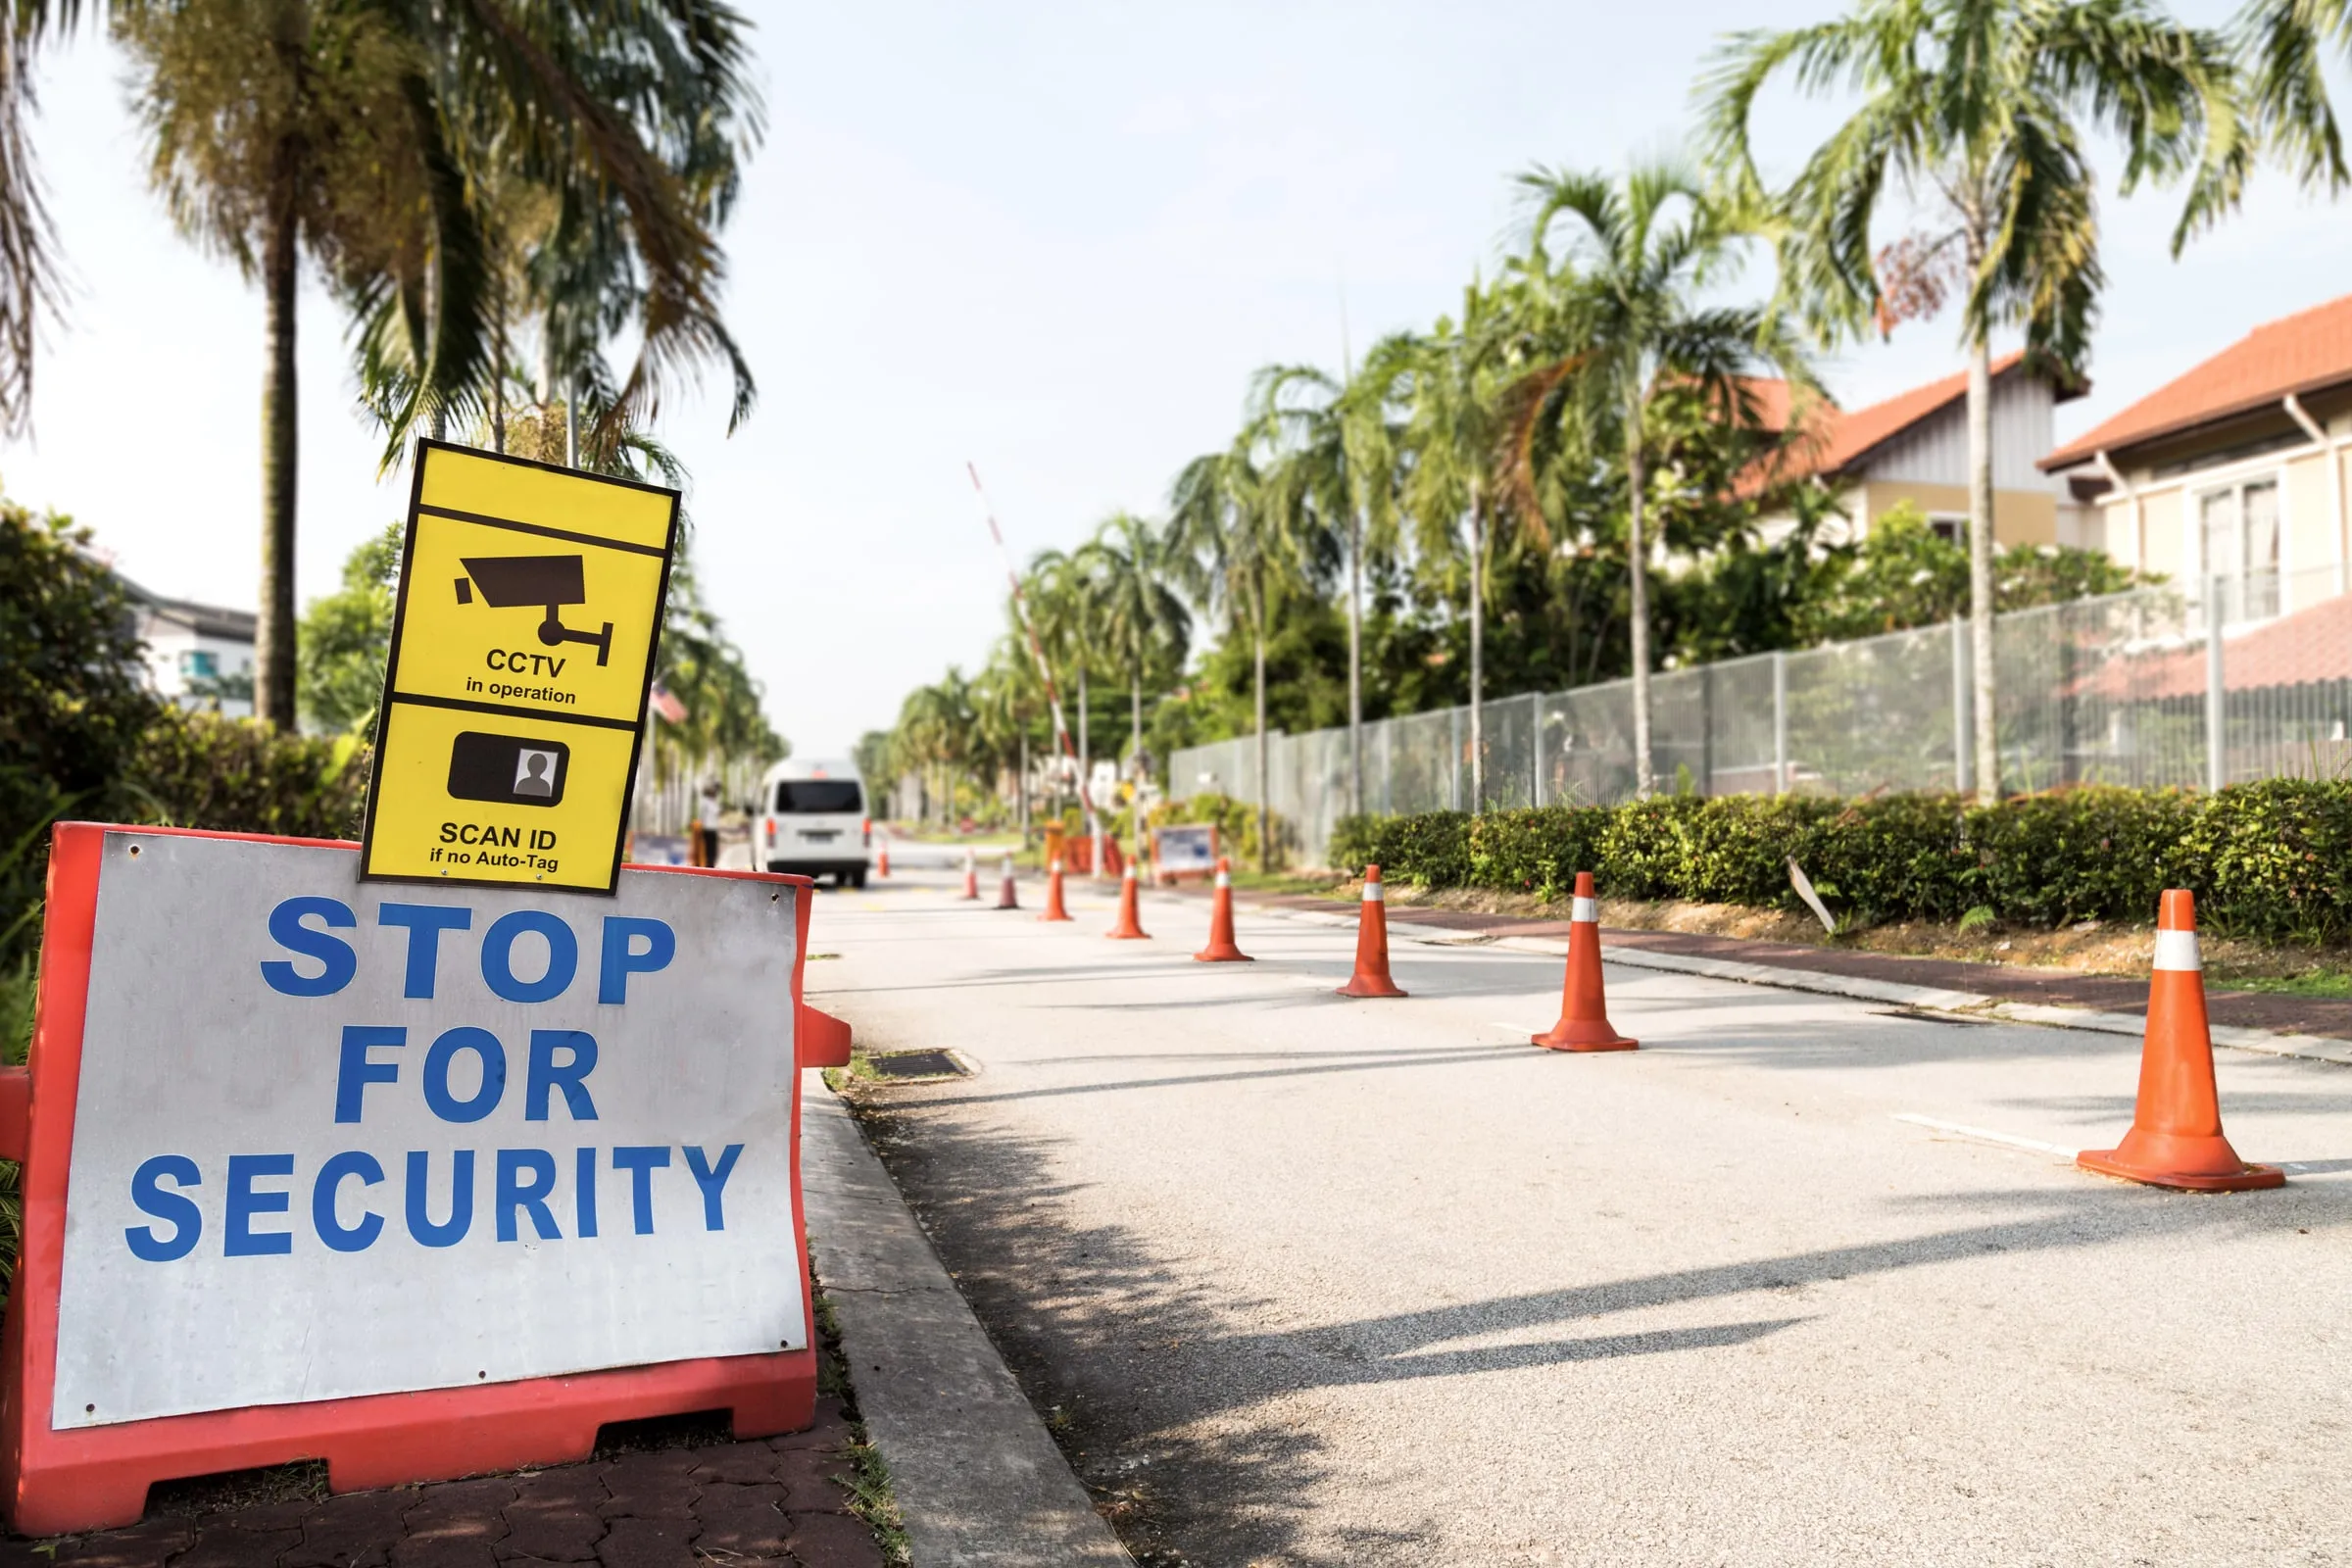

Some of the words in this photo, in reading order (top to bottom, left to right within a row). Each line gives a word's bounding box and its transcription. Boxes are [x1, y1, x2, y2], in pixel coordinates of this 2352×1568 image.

[486, 649, 566, 678] CCTV
[466, 676, 483, 692] in
[489, 683, 576, 705] operation
[439, 822, 521, 849] SCAN
[529, 829, 557, 851] ID
[429, 847, 444, 862] if
[447, 852, 471, 864] no
[475, 851, 559, 873] Auto-Tag
[261, 897, 675, 1004] STOP
[334, 1025, 599, 1123] FOR
[124, 1144, 745, 1262] SECURITY
